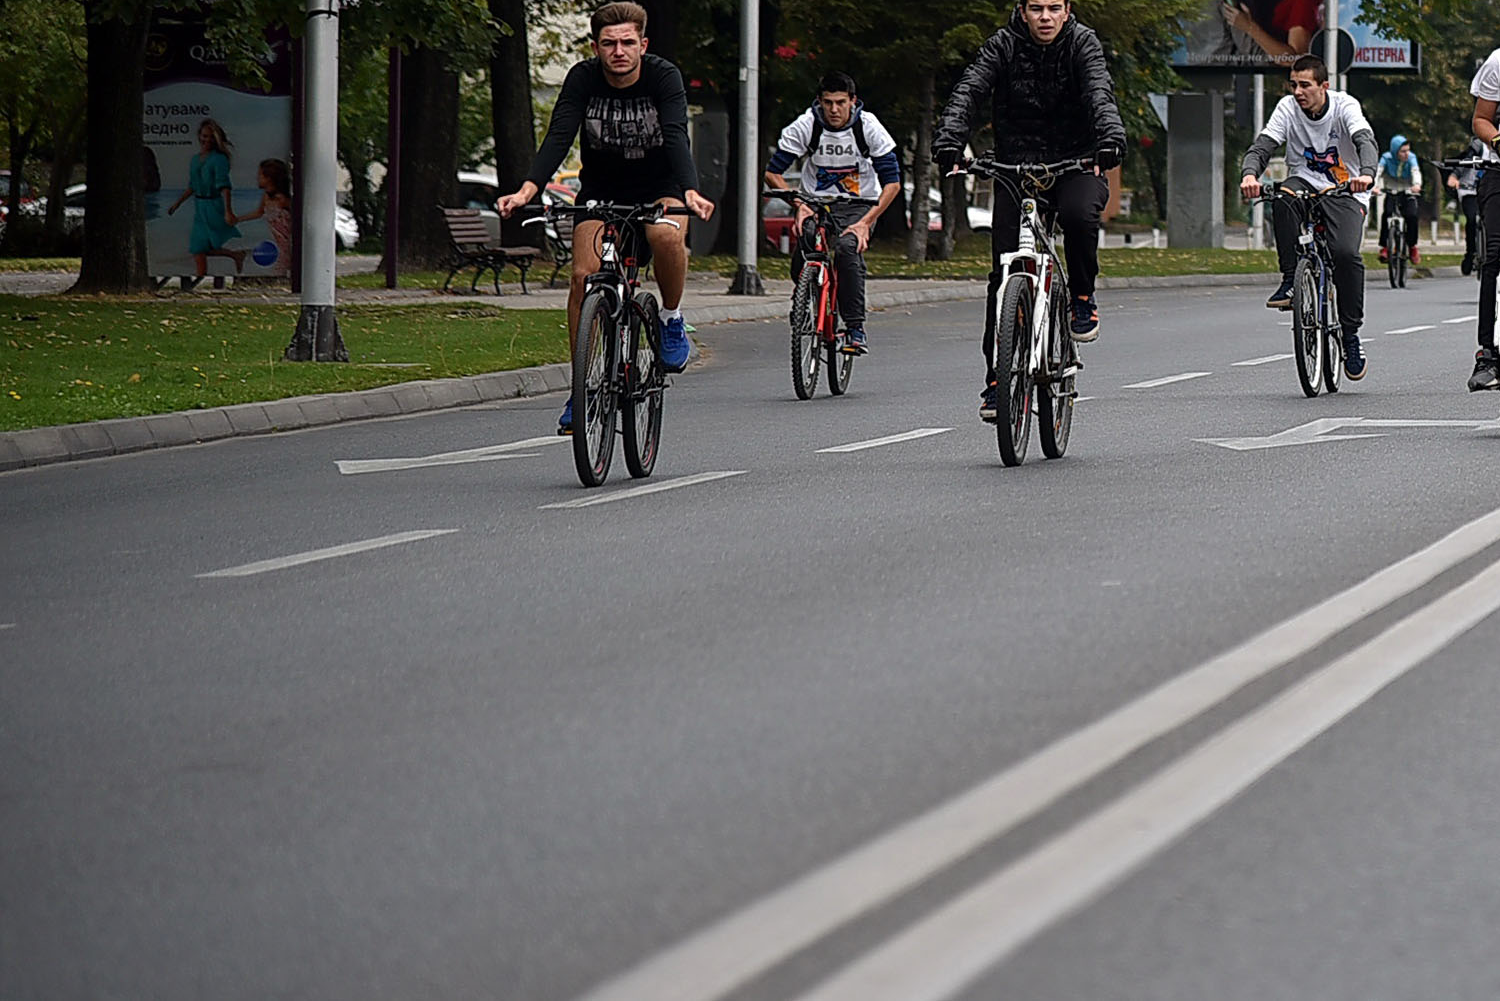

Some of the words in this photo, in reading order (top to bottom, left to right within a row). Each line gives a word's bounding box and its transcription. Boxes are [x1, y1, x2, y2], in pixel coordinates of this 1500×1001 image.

[1247, 53, 1262, 62] на
[144, 104, 211, 118] атуваме
[143, 122, 190, 135] аедно
[819, 143, 854, 156] 1504
